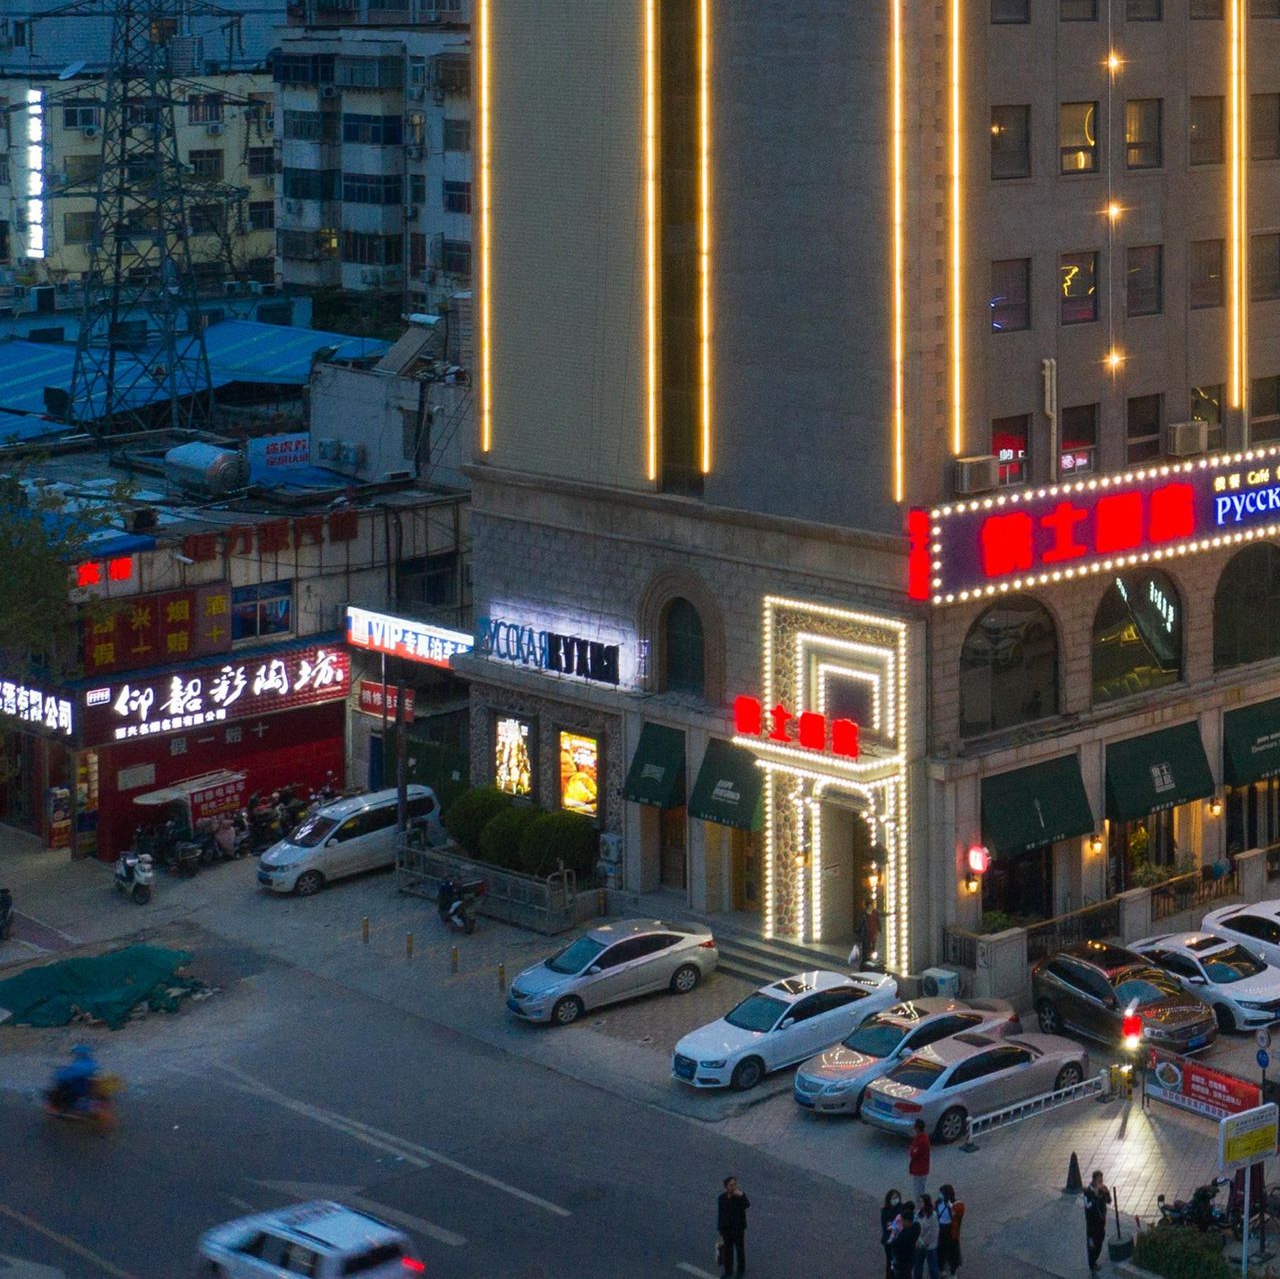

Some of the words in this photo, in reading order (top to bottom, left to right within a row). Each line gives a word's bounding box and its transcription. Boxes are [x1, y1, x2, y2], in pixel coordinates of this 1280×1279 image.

[1247, 468, 1270, 485] Café
[371, 620, 403, 650] VIP
[113, 650, 344, 721] 仰韶彩陶坊
[170, 721, 270, 757] 假一赔十
